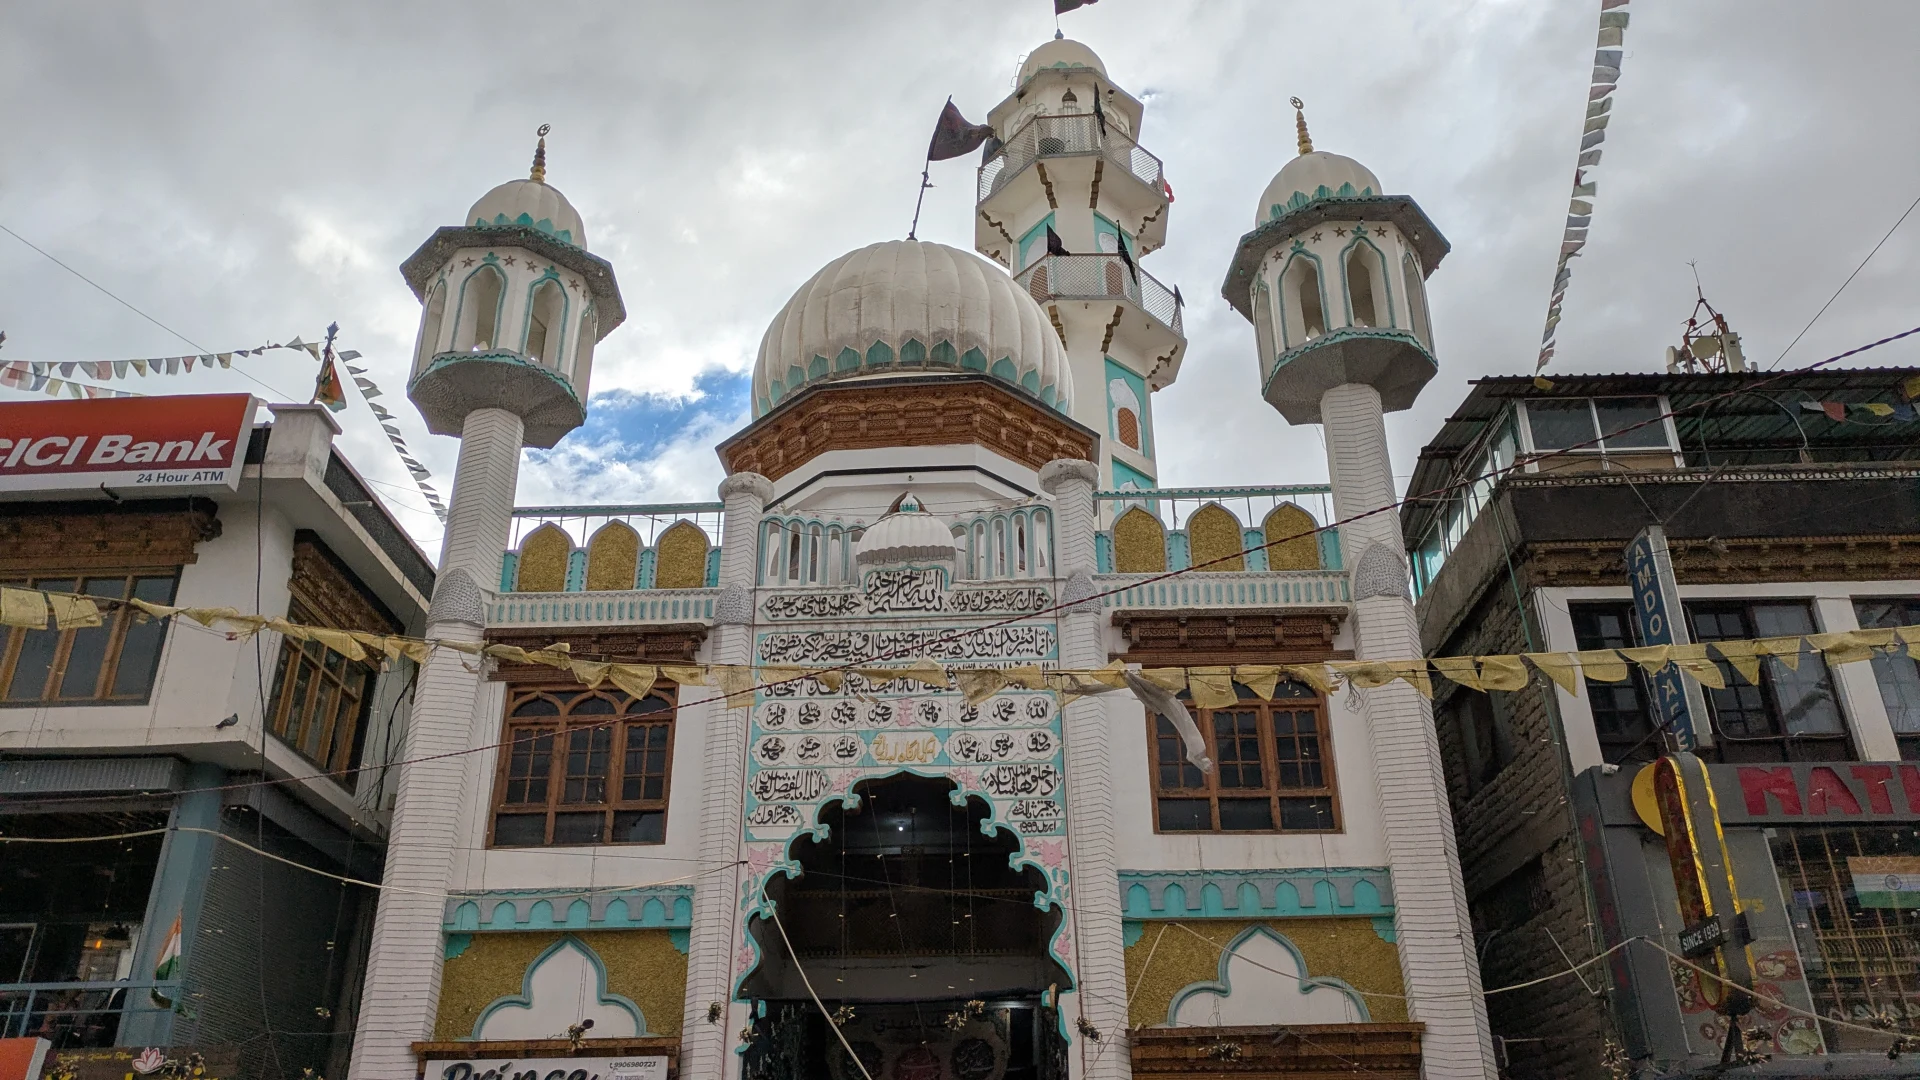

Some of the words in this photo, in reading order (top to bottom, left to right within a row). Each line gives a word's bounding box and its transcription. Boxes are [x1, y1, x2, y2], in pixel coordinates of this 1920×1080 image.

[86, 431, 231, 465] Bank
[136, 473, 153, 484] 24
[156, 472, 190, 483] Hour
[191, 471, 224, 482] ATM
[1634, 543, 1662, 637] AMDO
[1682, 930, 1704, 952] SINCE
[1703, 921, 1721, 941] 1939
